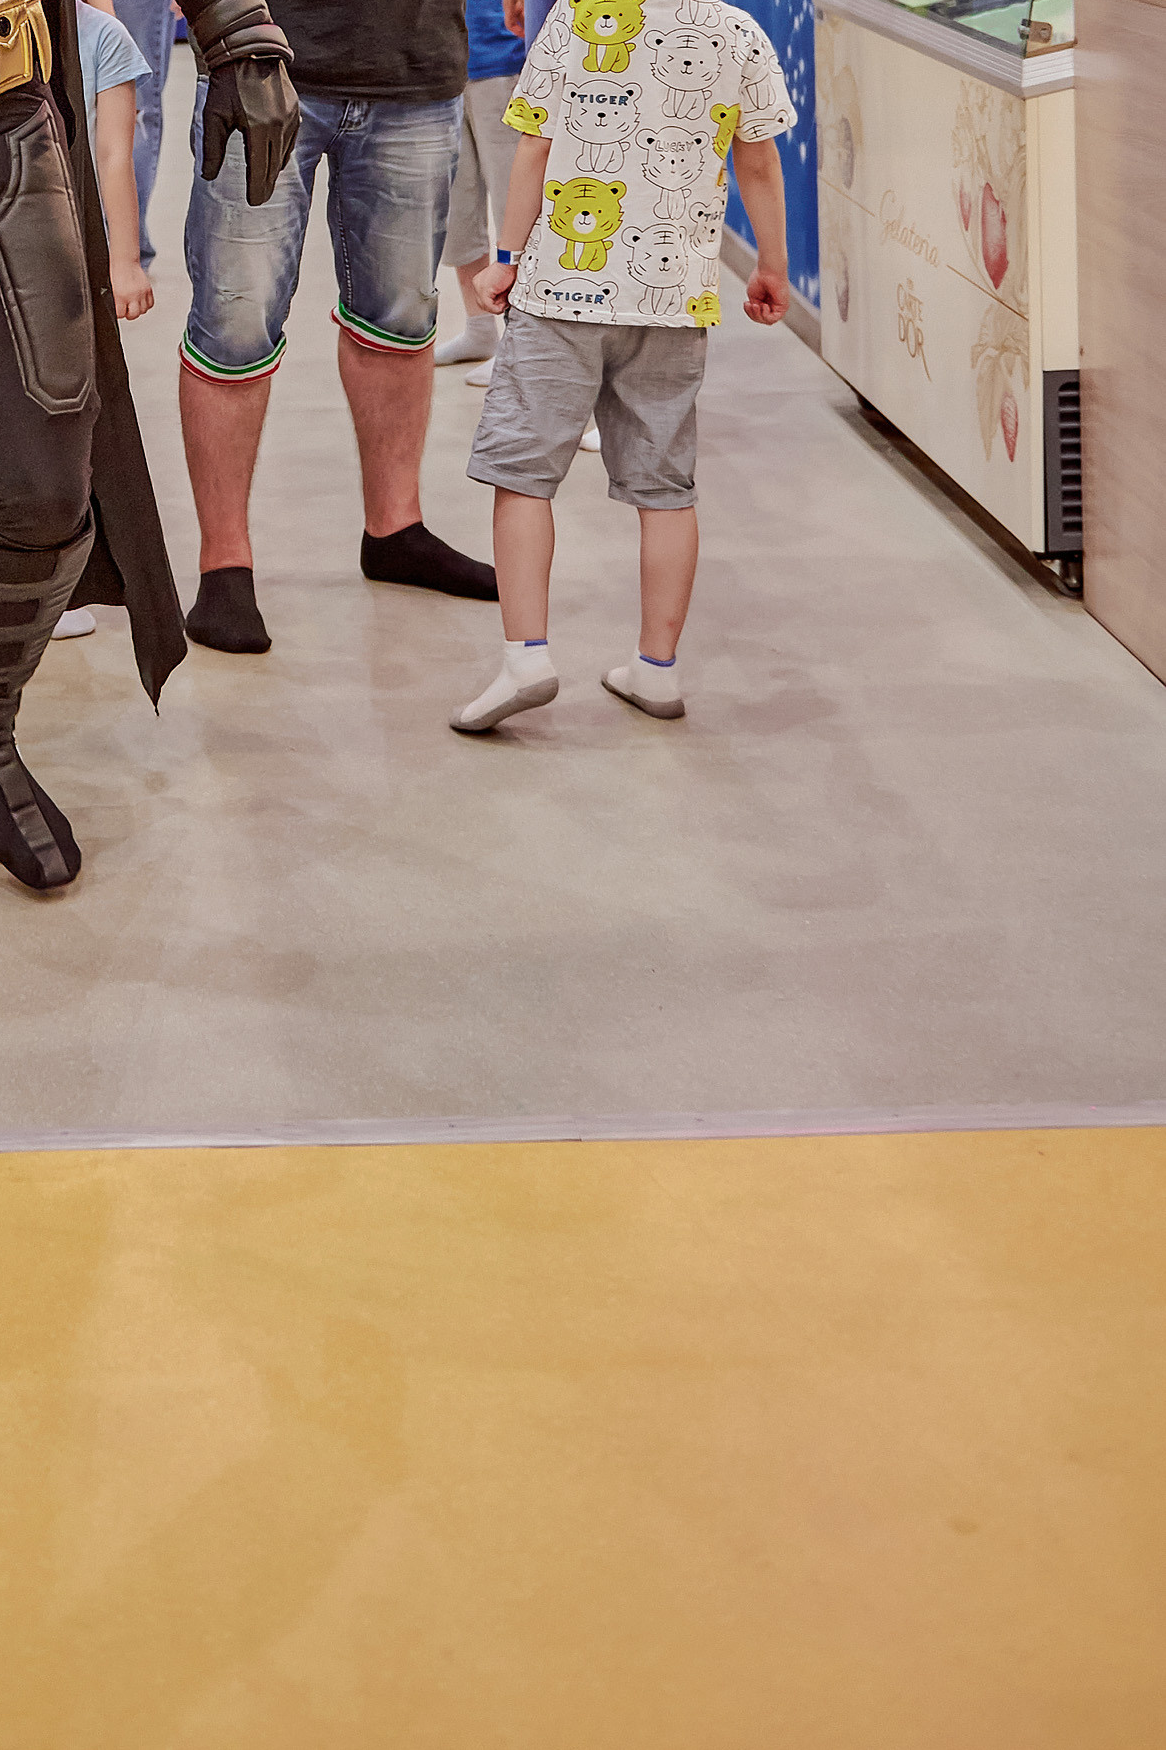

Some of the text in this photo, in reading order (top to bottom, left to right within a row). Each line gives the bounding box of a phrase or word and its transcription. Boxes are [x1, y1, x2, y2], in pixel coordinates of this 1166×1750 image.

[577, 94, 629, 106] TIGER
[655, 140, 694, 152] LUCKY
[552, 291, 606, 305] TIGER
